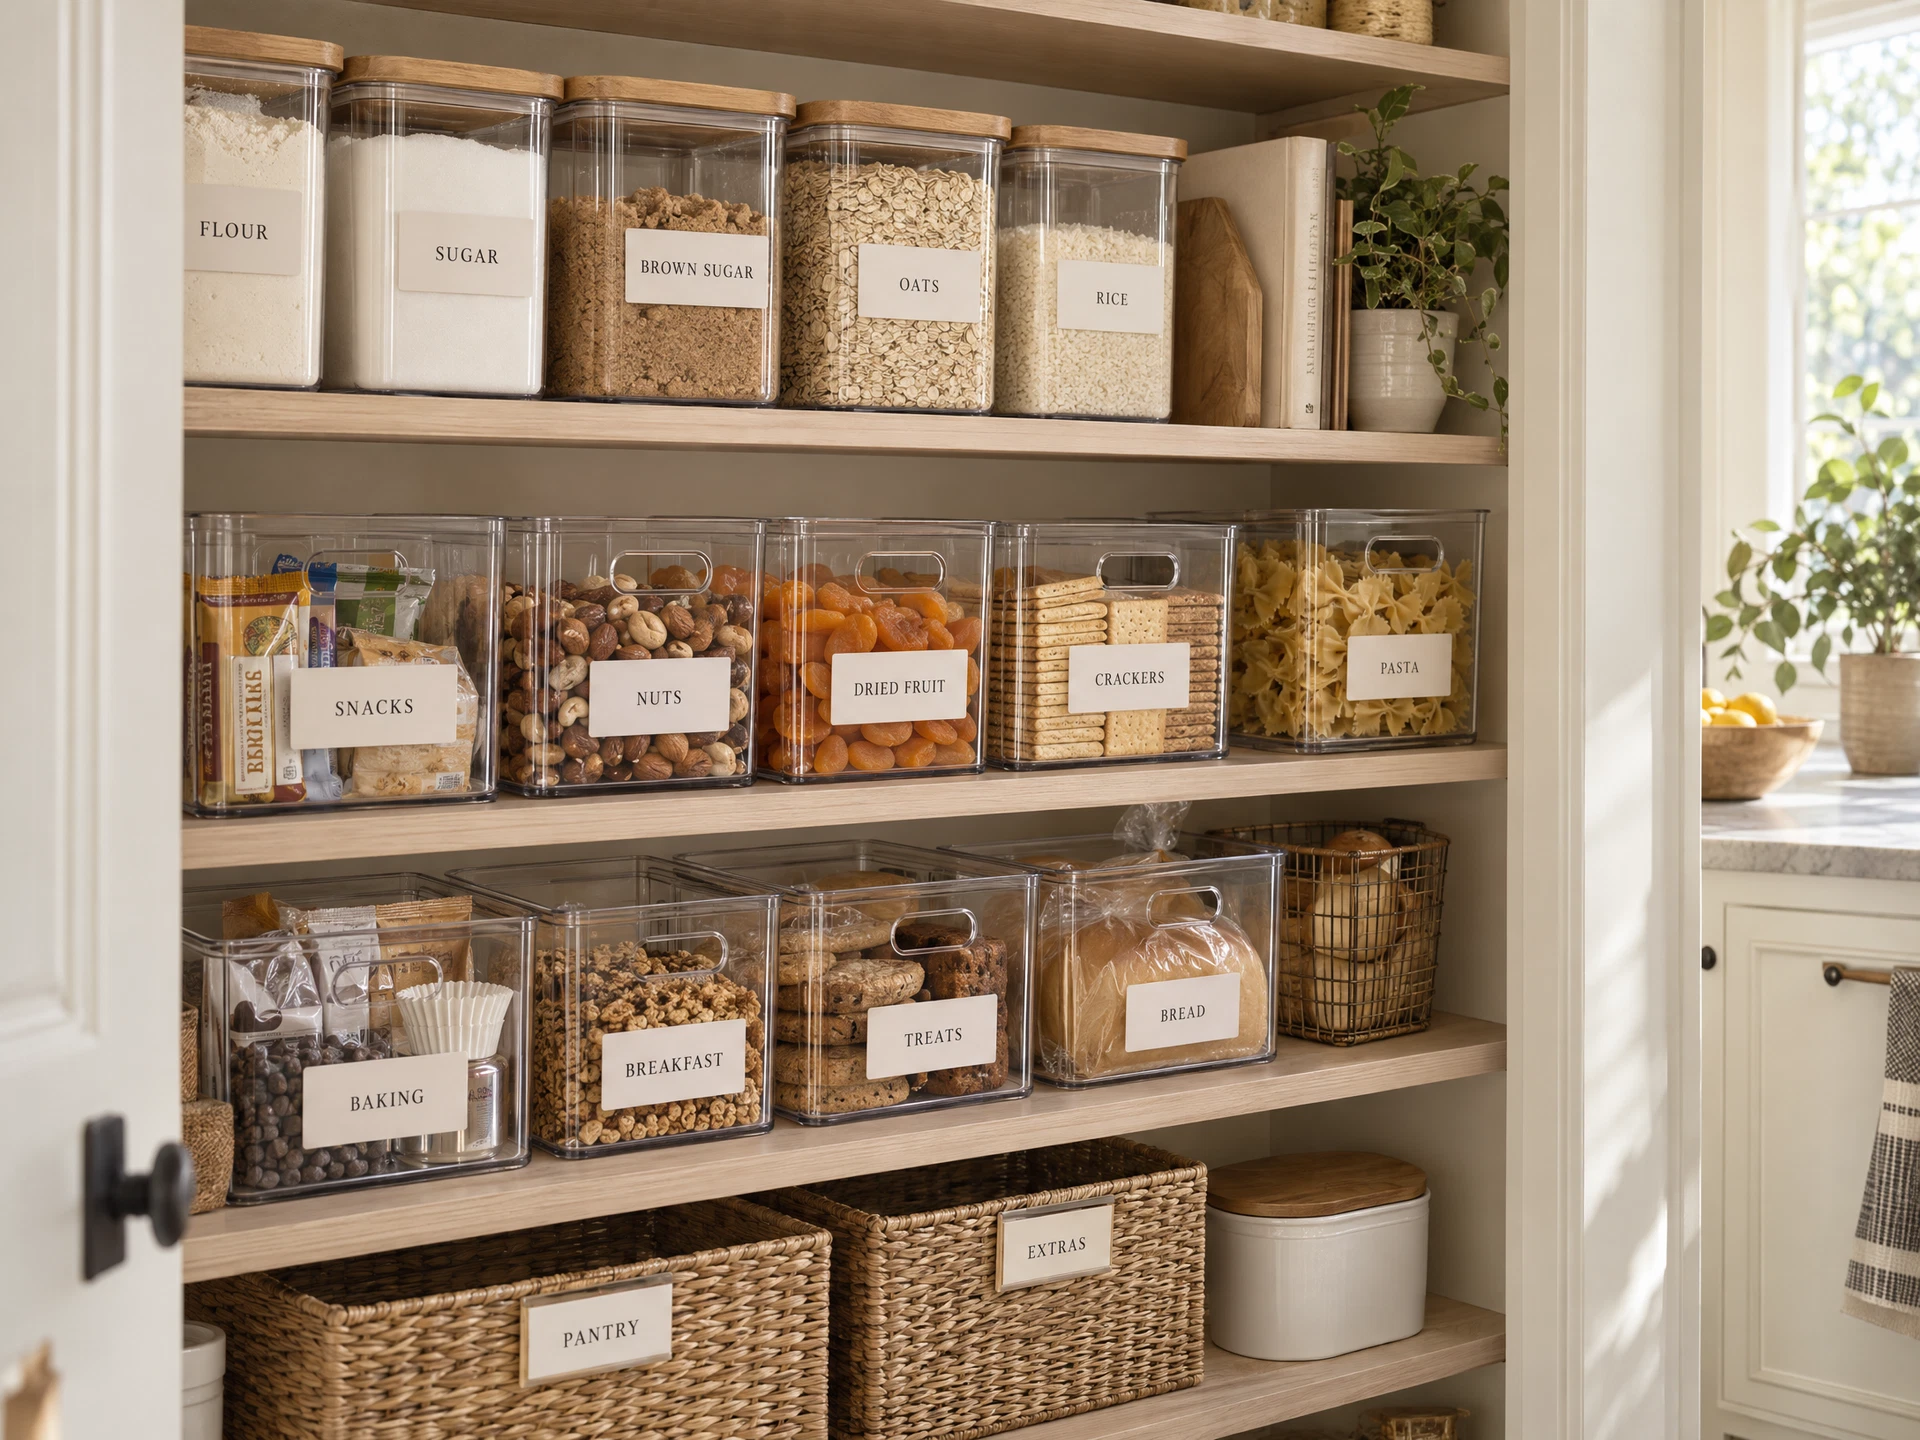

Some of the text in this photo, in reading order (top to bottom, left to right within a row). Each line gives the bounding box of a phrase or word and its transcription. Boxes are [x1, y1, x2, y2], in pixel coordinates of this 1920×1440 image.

[199, 220, 268, 241] FLOUR
[435, 245, 499, 265] SUGAR
[640, 259, 754, 280] BROWN SUGAR
[899, 277, 939, 294] OATS
[1096, 291, 1129, 306] RICE
[1380, 661, 1419, 675] PASTA
[853, 679, 946, 697] DRIED FRUIT
[1095, 670, 1165, 687] CRACKERS
[636, 689, 682, 706] NUTS
[335, 698, 414, 717] SNACKS
[1160, 1004, 1206, 1023] BREAD
[904, 1027, 963, 1048] TREATS
[625, 1051, 724, 1078] BREAKFAST
[350, 1088, 424, 1112] BAKING
[1027, 1236, 1086, 1260] EXTRAS
[563, 1318, 639, 1349] PANTRY
